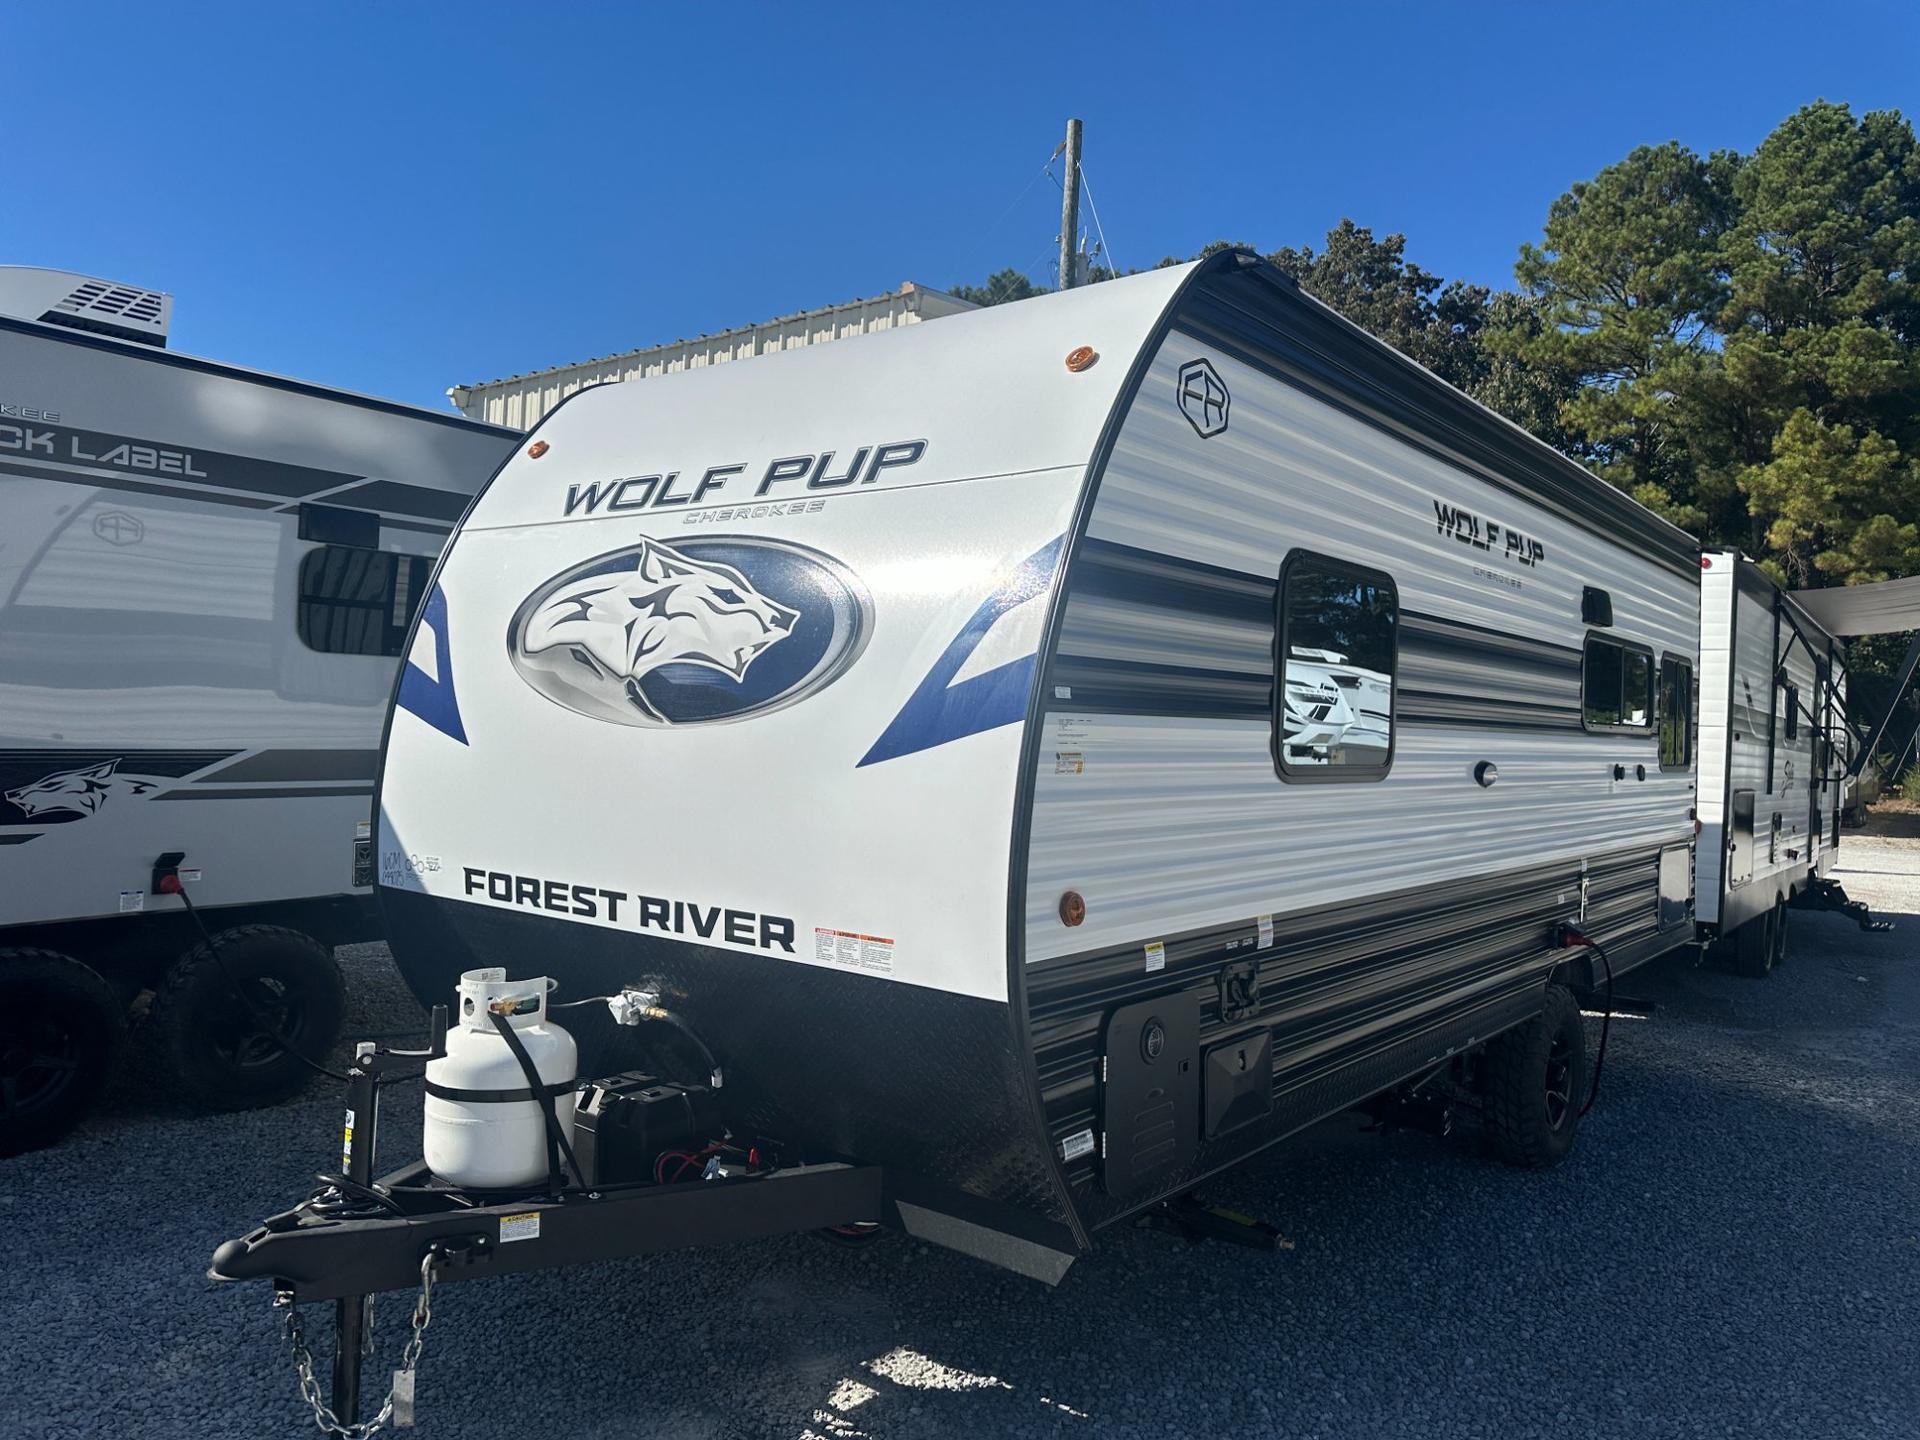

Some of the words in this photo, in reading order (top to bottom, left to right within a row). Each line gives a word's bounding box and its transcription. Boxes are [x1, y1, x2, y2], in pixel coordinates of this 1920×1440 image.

[71, 436, 207, 478] LABEL
[564, 462, 748, 517] WOLF
[755, 438, 929, 497] PUP
[682, 500, 826, 525] CHEROKEE
[1433, 499, 1499, 552] WOLF
[1504, 528, 1545, 568] PUP
[463, 866, 628, 922] FOREST
[637, 894, 796, 954] RIVER
